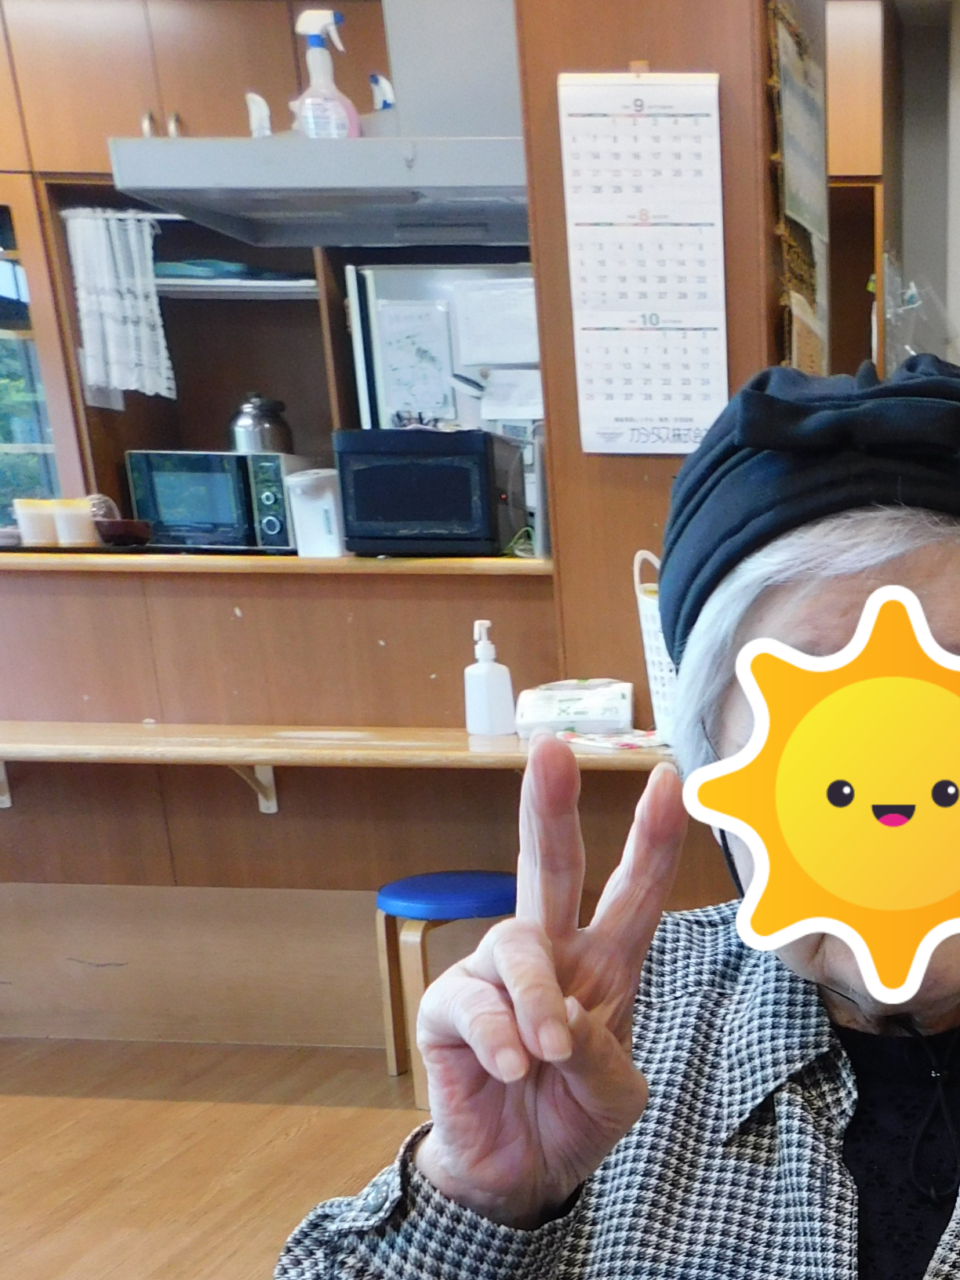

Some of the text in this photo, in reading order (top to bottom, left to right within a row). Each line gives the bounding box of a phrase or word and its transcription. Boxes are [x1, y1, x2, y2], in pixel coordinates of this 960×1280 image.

[633, 98, 645, 112] 9
[639, 208, 649, 222] 8
[640, 312, 660, 326] 10
